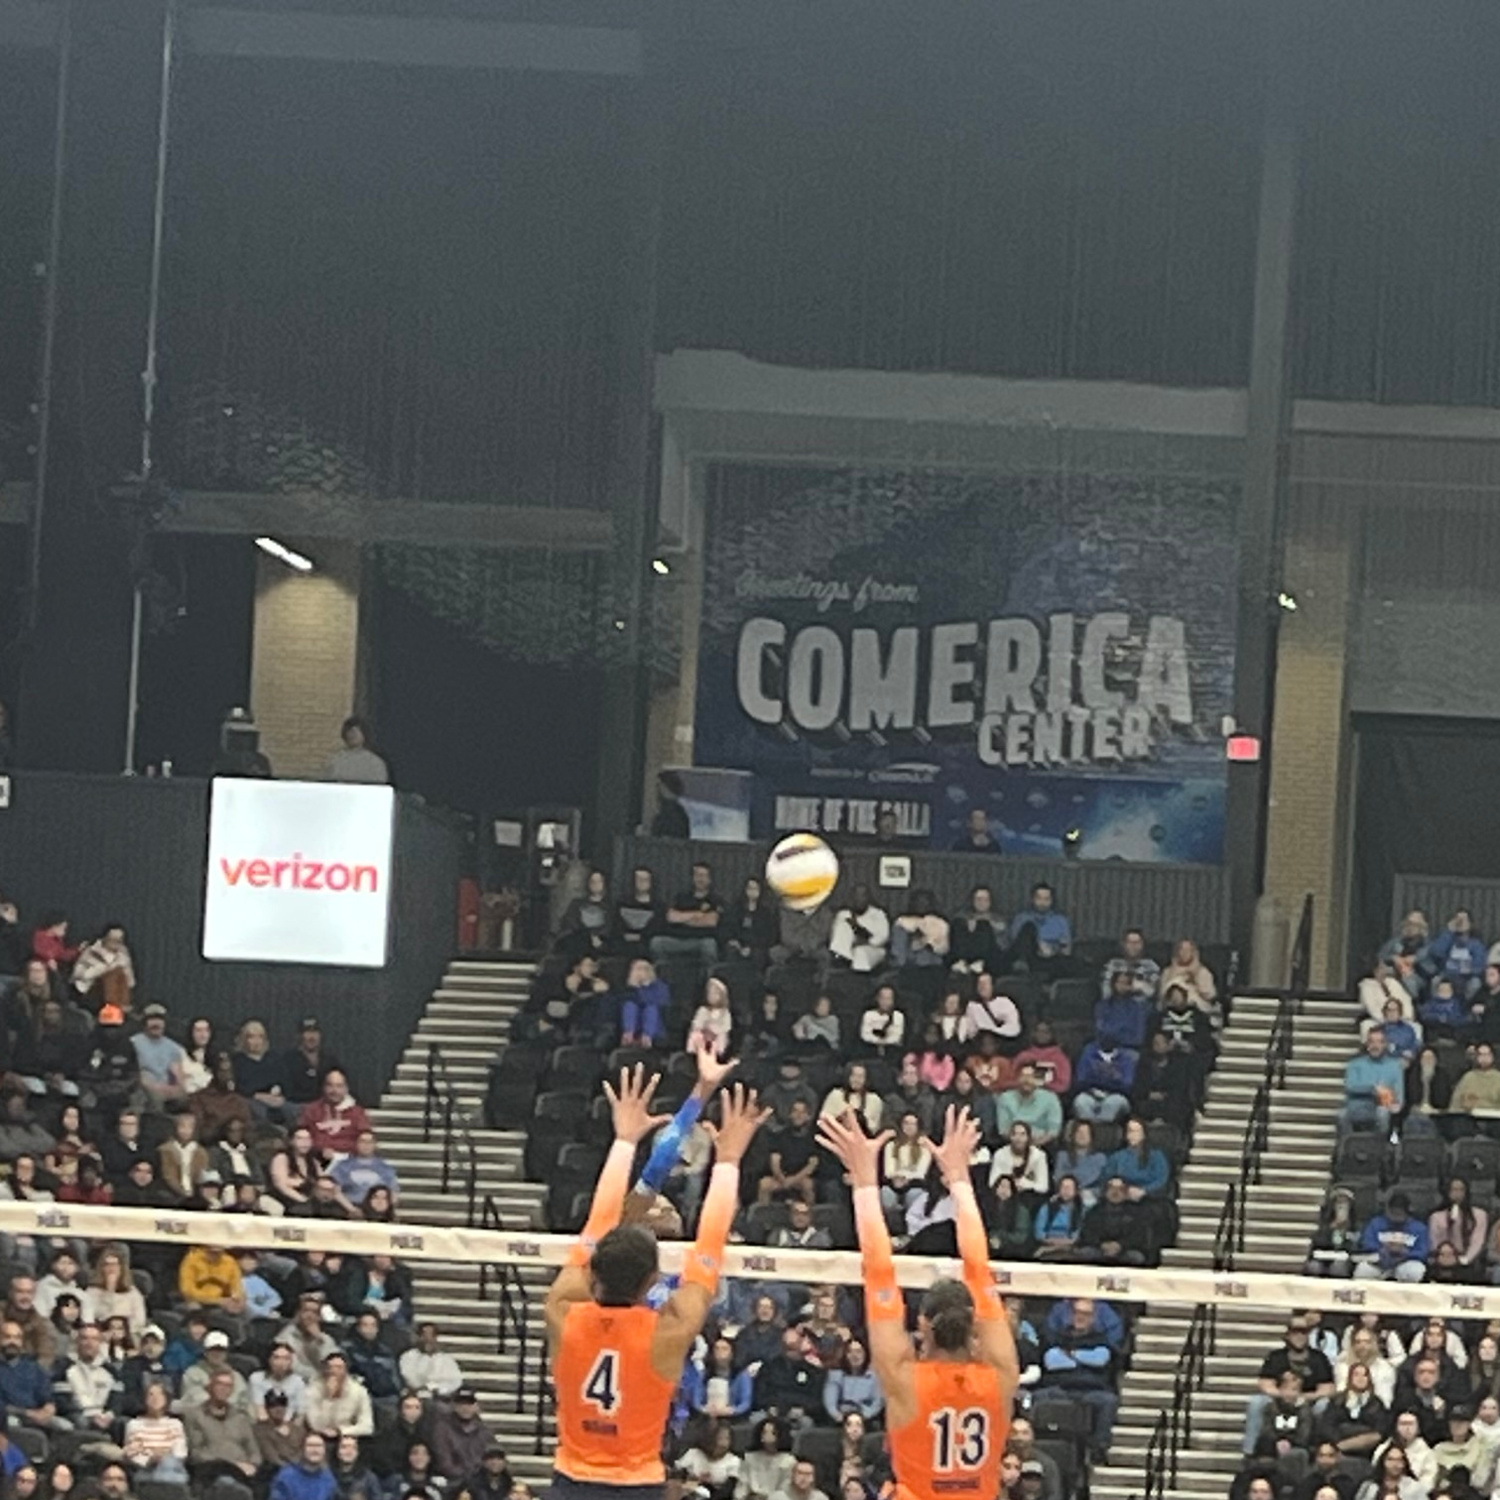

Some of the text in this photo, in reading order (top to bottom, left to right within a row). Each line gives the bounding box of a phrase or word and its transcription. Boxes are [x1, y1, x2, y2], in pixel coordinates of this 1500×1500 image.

[736, 611, 1194, 731] COMERICA
[977, 710, 1151, 766] CENTER
[220, 853, 378, 893] verizon
[581, 1348, 621, 1416] 4
[929, 1406, 990, 1474] 13
